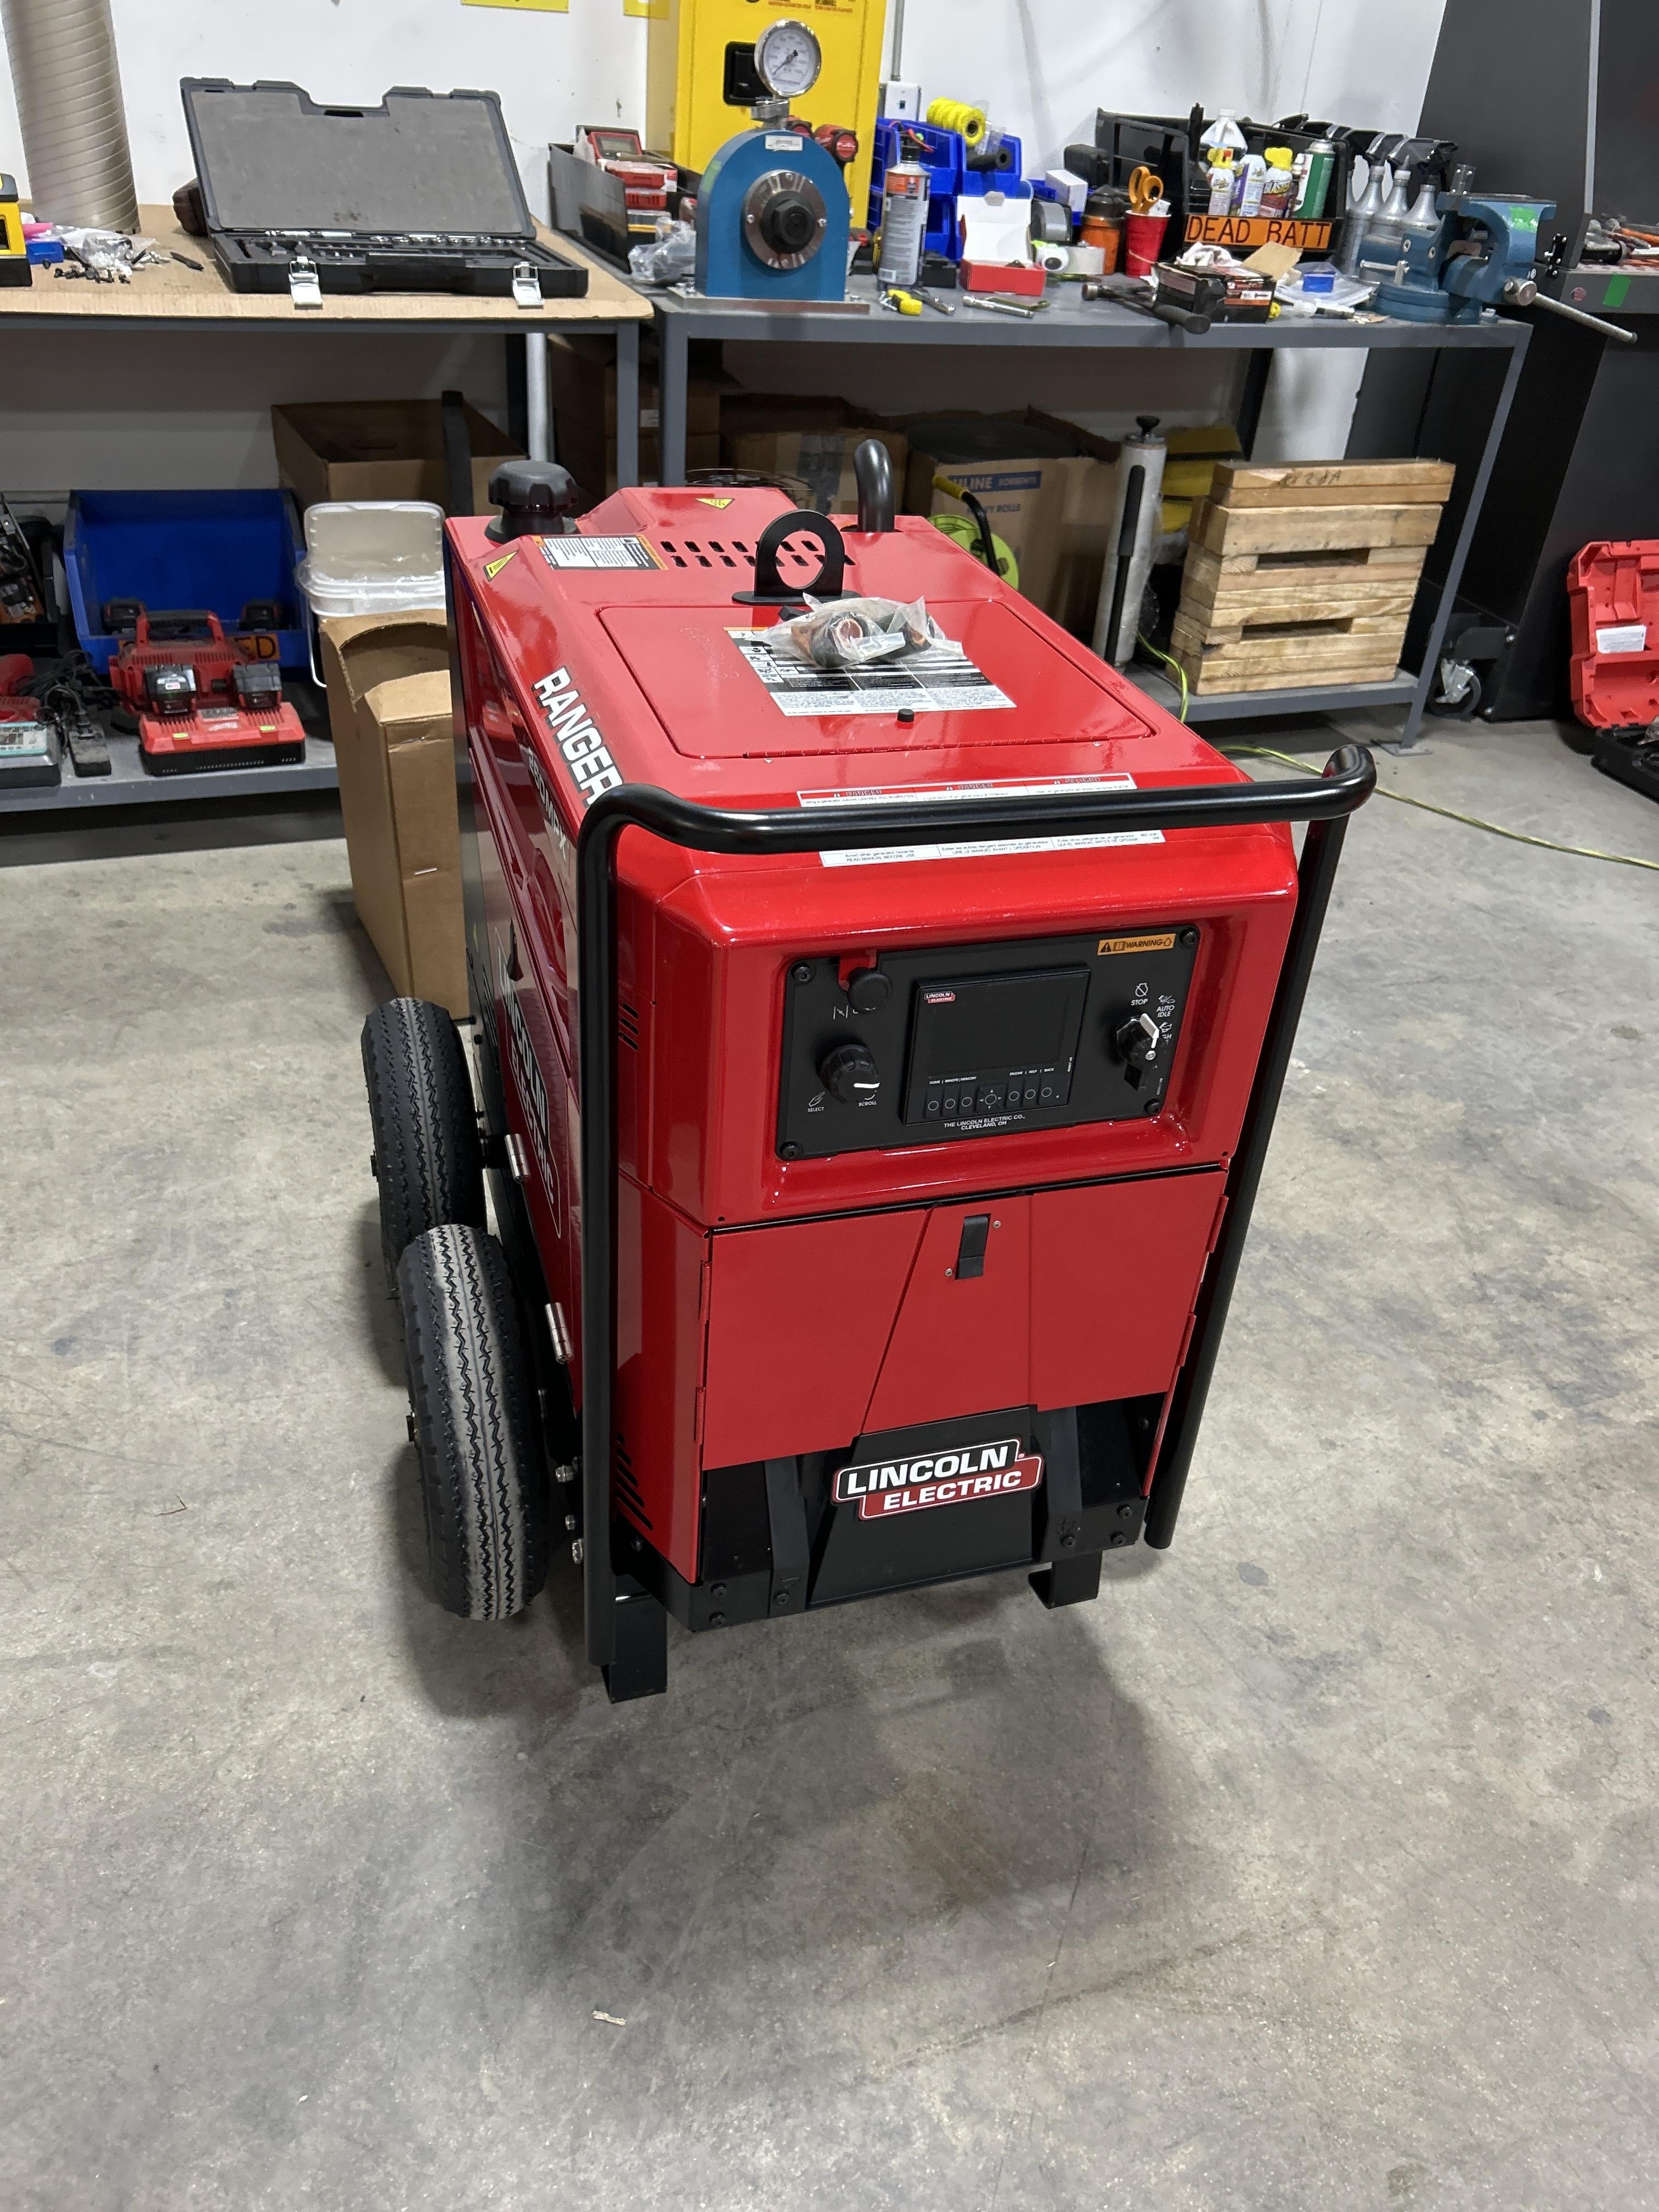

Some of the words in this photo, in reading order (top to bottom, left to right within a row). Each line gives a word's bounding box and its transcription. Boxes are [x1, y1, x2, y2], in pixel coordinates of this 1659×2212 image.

[1187, 216, 1250, 242] DEAD
[1267, 221, 1330, 246] BATT
[533, 667, 623, 805] RANGER
[1126, 939, 1163, 948] WARNING
[498, 946, 546, 1137] LINCOLN
[511, 1035, 554, 1204] ELECTRIC
[847, 1446, 1009, 1496] LINCOLN
[883, 1471, 1022, 1511] ELECTRIC
